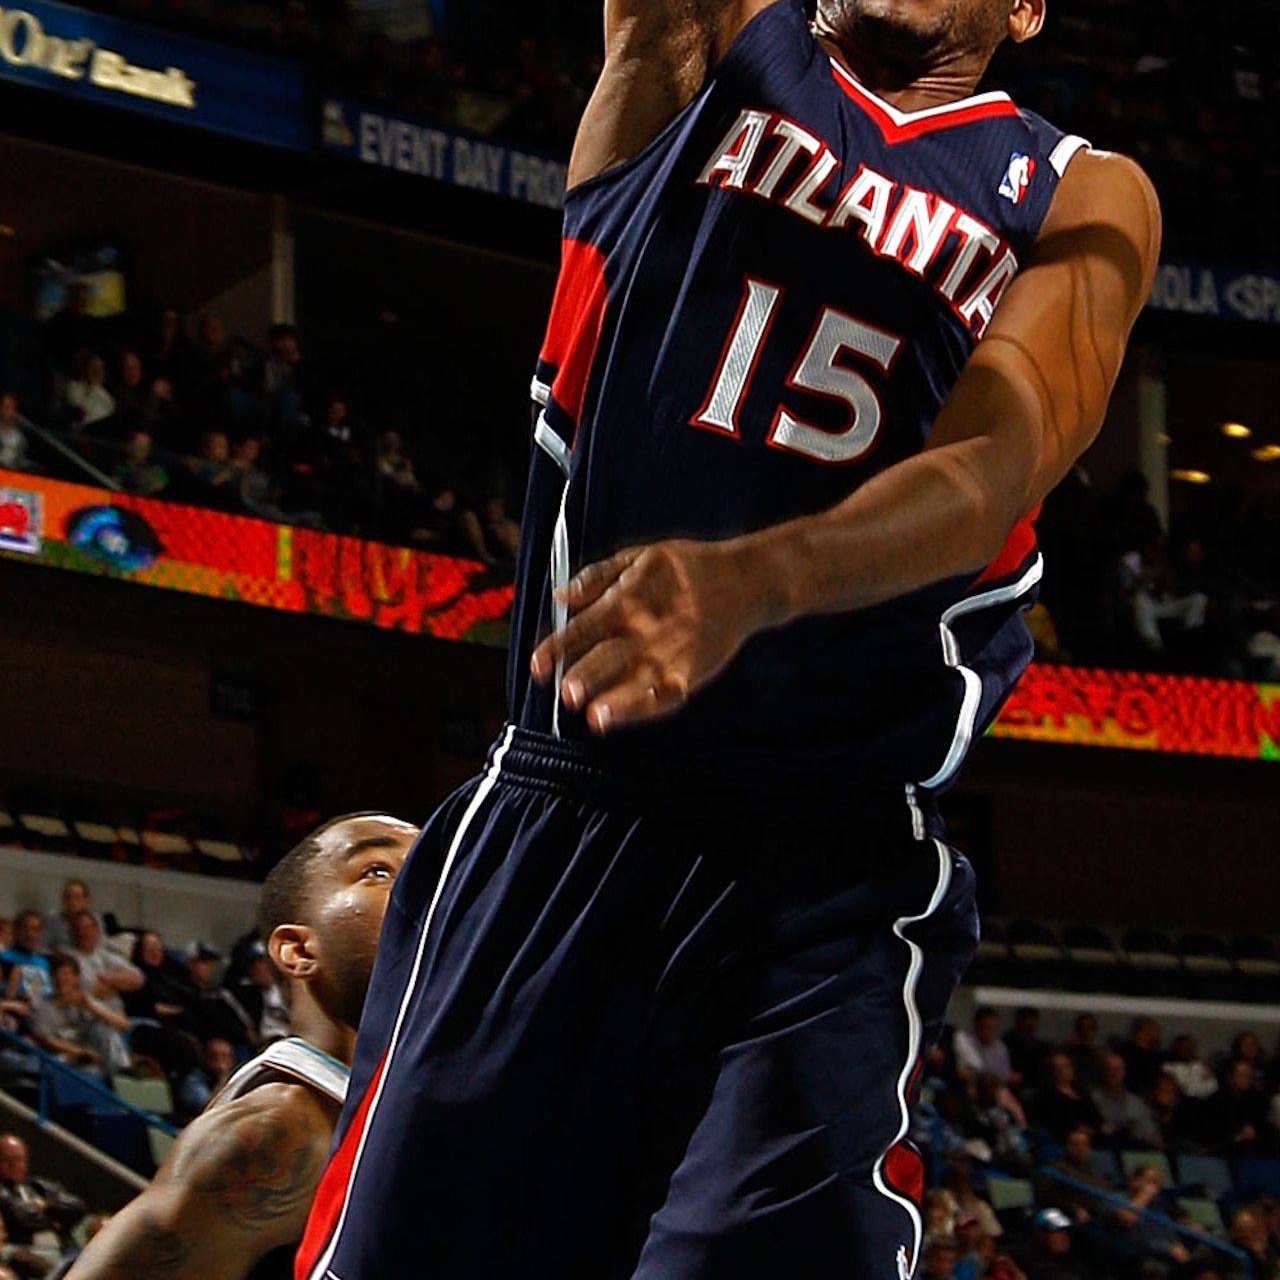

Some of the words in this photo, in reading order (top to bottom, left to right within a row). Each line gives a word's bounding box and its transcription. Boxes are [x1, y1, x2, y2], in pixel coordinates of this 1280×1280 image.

[359, 111, 450, 181] EVENT
[452, 134, 507, 195] DAY
[694, 105, 1020, 341] ATLANTA
[690, 273, 904, 464] 15
